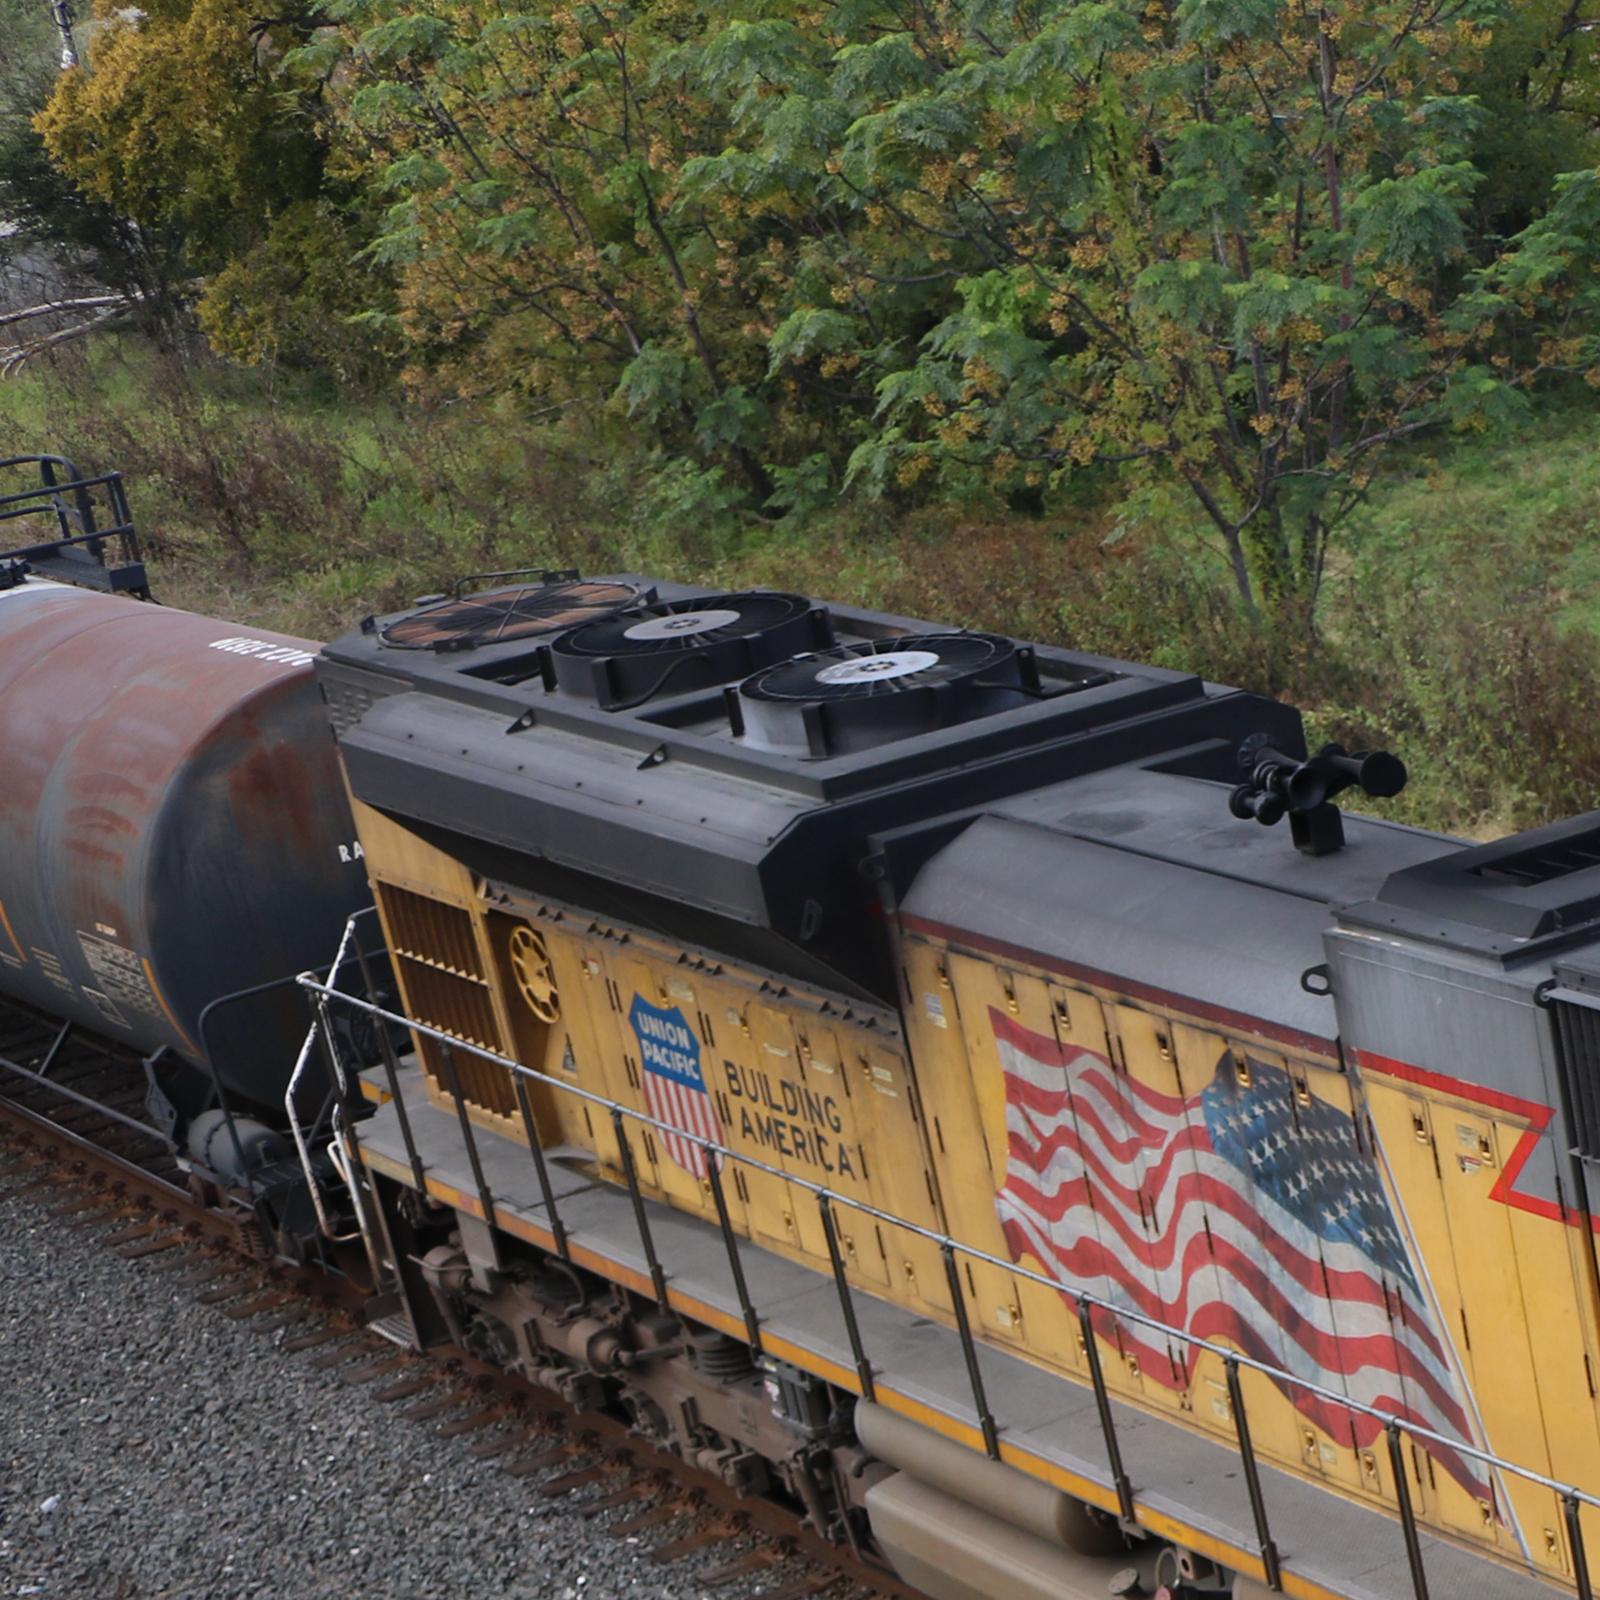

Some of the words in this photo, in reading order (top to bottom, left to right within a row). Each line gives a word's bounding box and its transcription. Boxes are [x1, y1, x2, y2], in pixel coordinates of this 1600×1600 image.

[637, 1012, 690, 1050] UNION
[641, 1038, 700, 1081] PACIFIC
[724, 1060, 842, 1133] BUILDING
[740, 1106, 858, 1182] AMERICA
